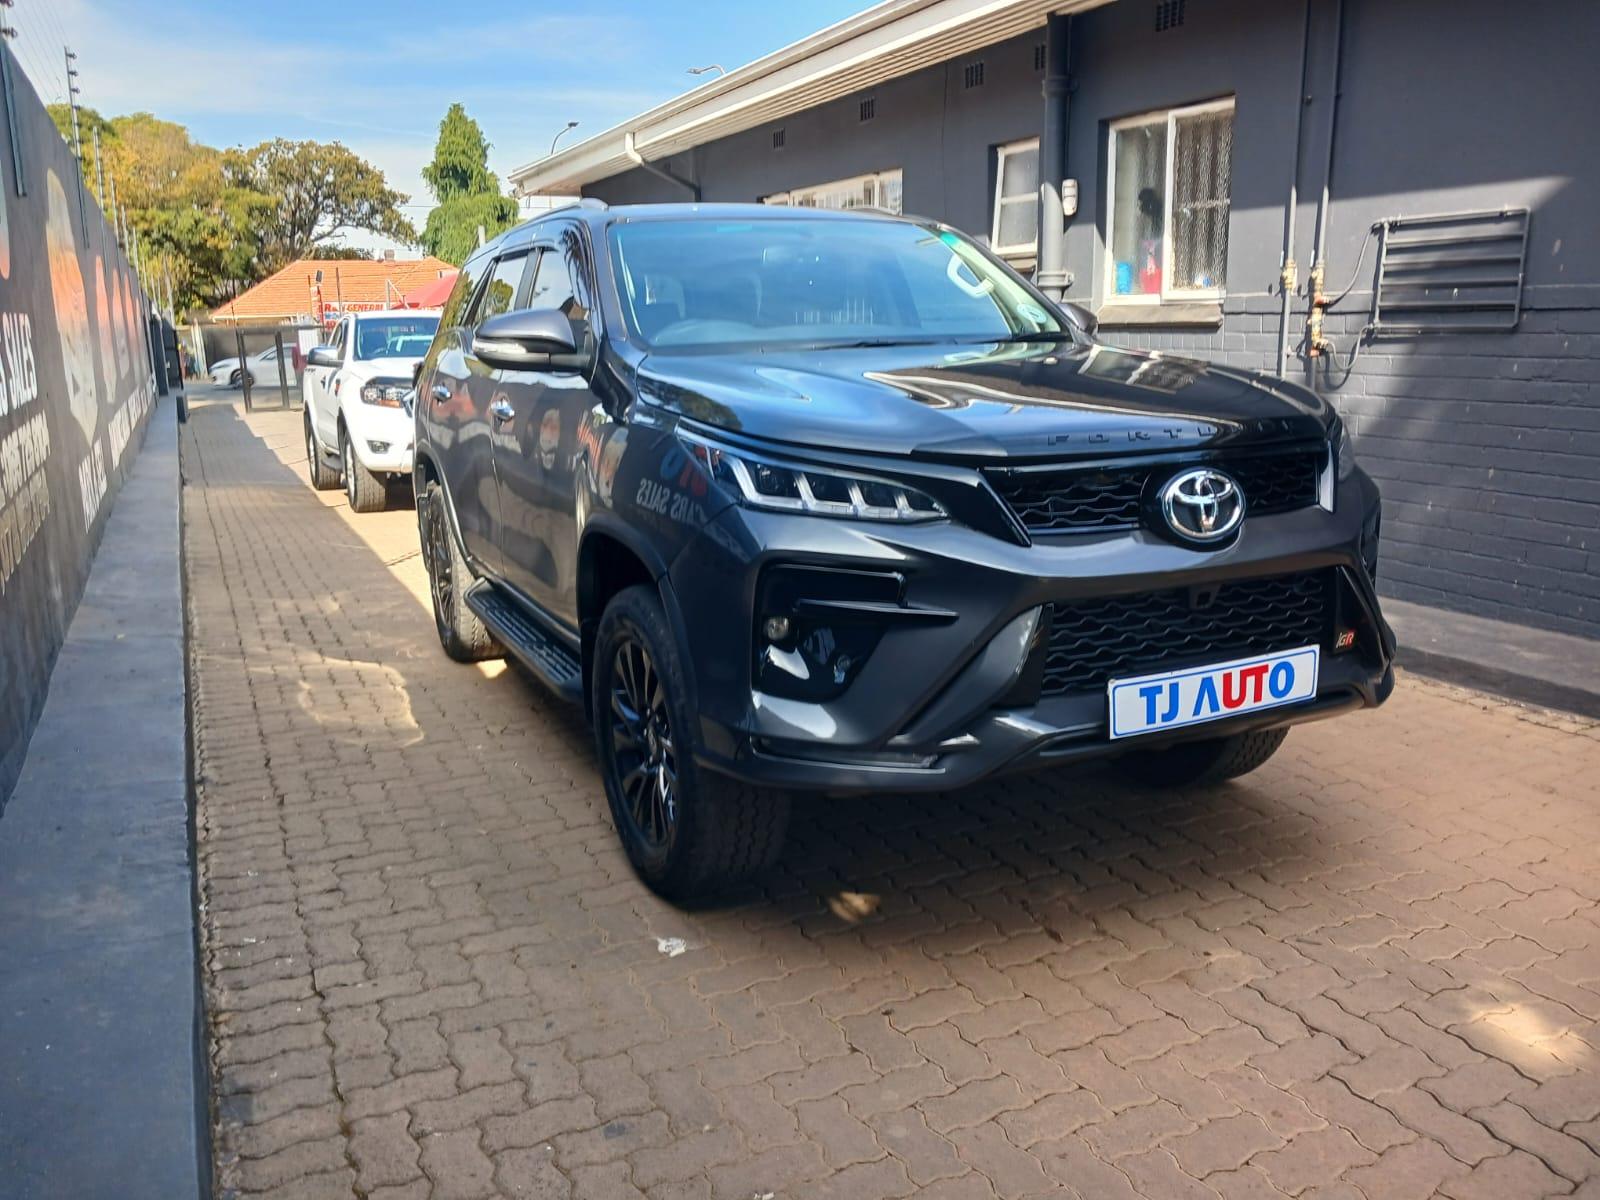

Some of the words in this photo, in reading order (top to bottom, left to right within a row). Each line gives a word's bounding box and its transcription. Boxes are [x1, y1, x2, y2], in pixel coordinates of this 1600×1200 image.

[3, 312, 38, 410] SALES
[1140, 682, 1179, 725] TJ
[1192, 661, 1295, 718] AUTO
